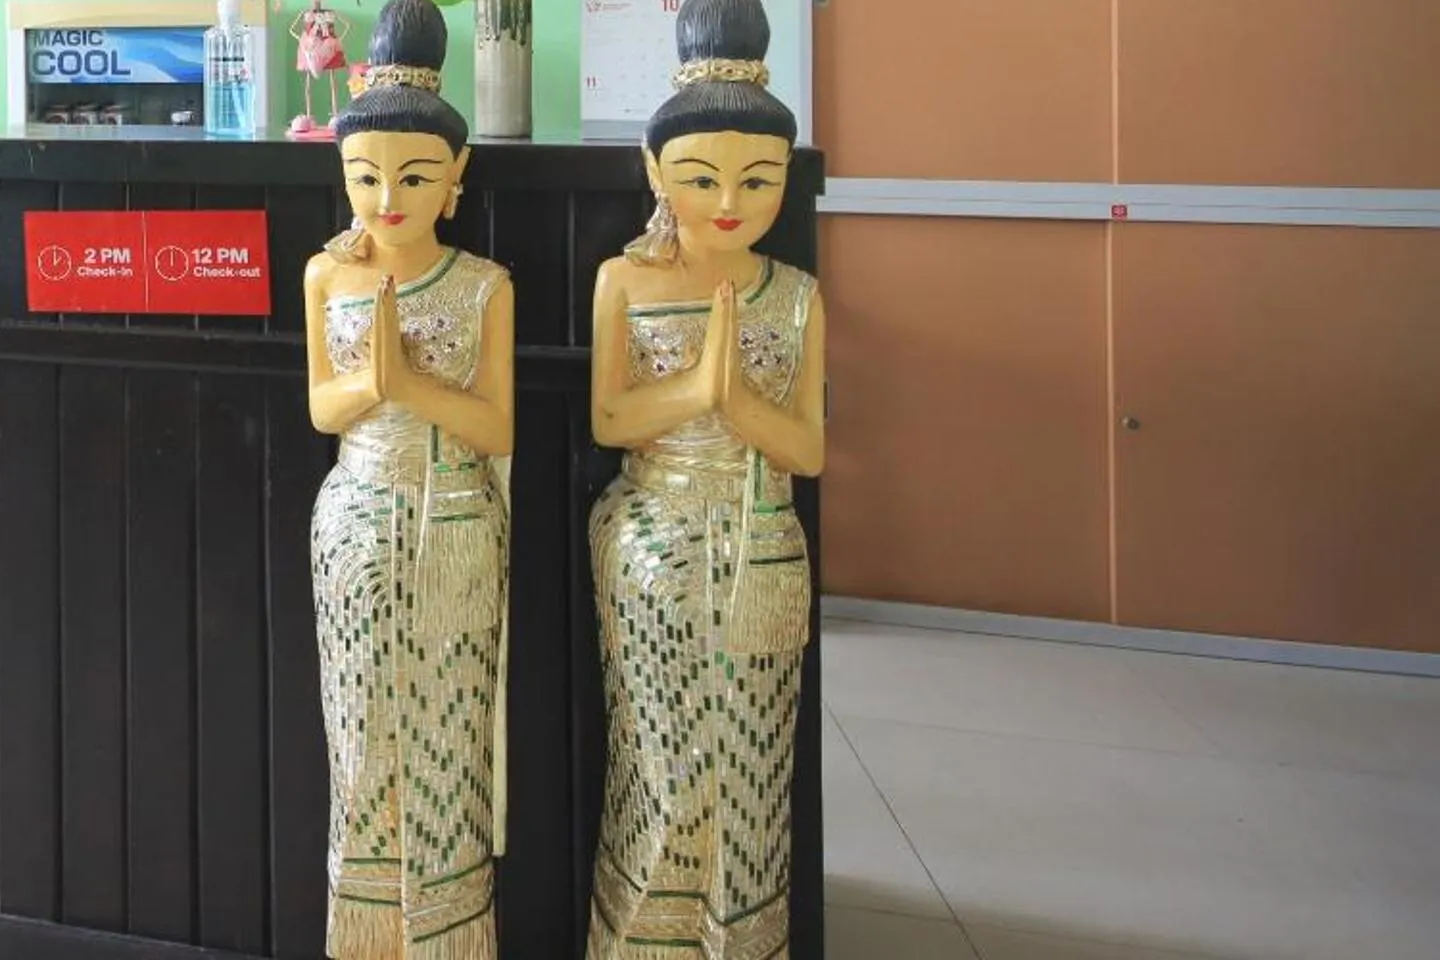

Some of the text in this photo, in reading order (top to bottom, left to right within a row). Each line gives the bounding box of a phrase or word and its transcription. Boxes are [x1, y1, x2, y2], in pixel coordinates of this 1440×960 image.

[34, 29, 103, 47] MAGIC
[32, 49, 131, 76] COOL
[84, 248, 131, 264] 2 PM
[192, 248, 249, 264] 12 PM
[77, 265, 133, 278] Check-in
[193, 265, 260, 278] Check-out
